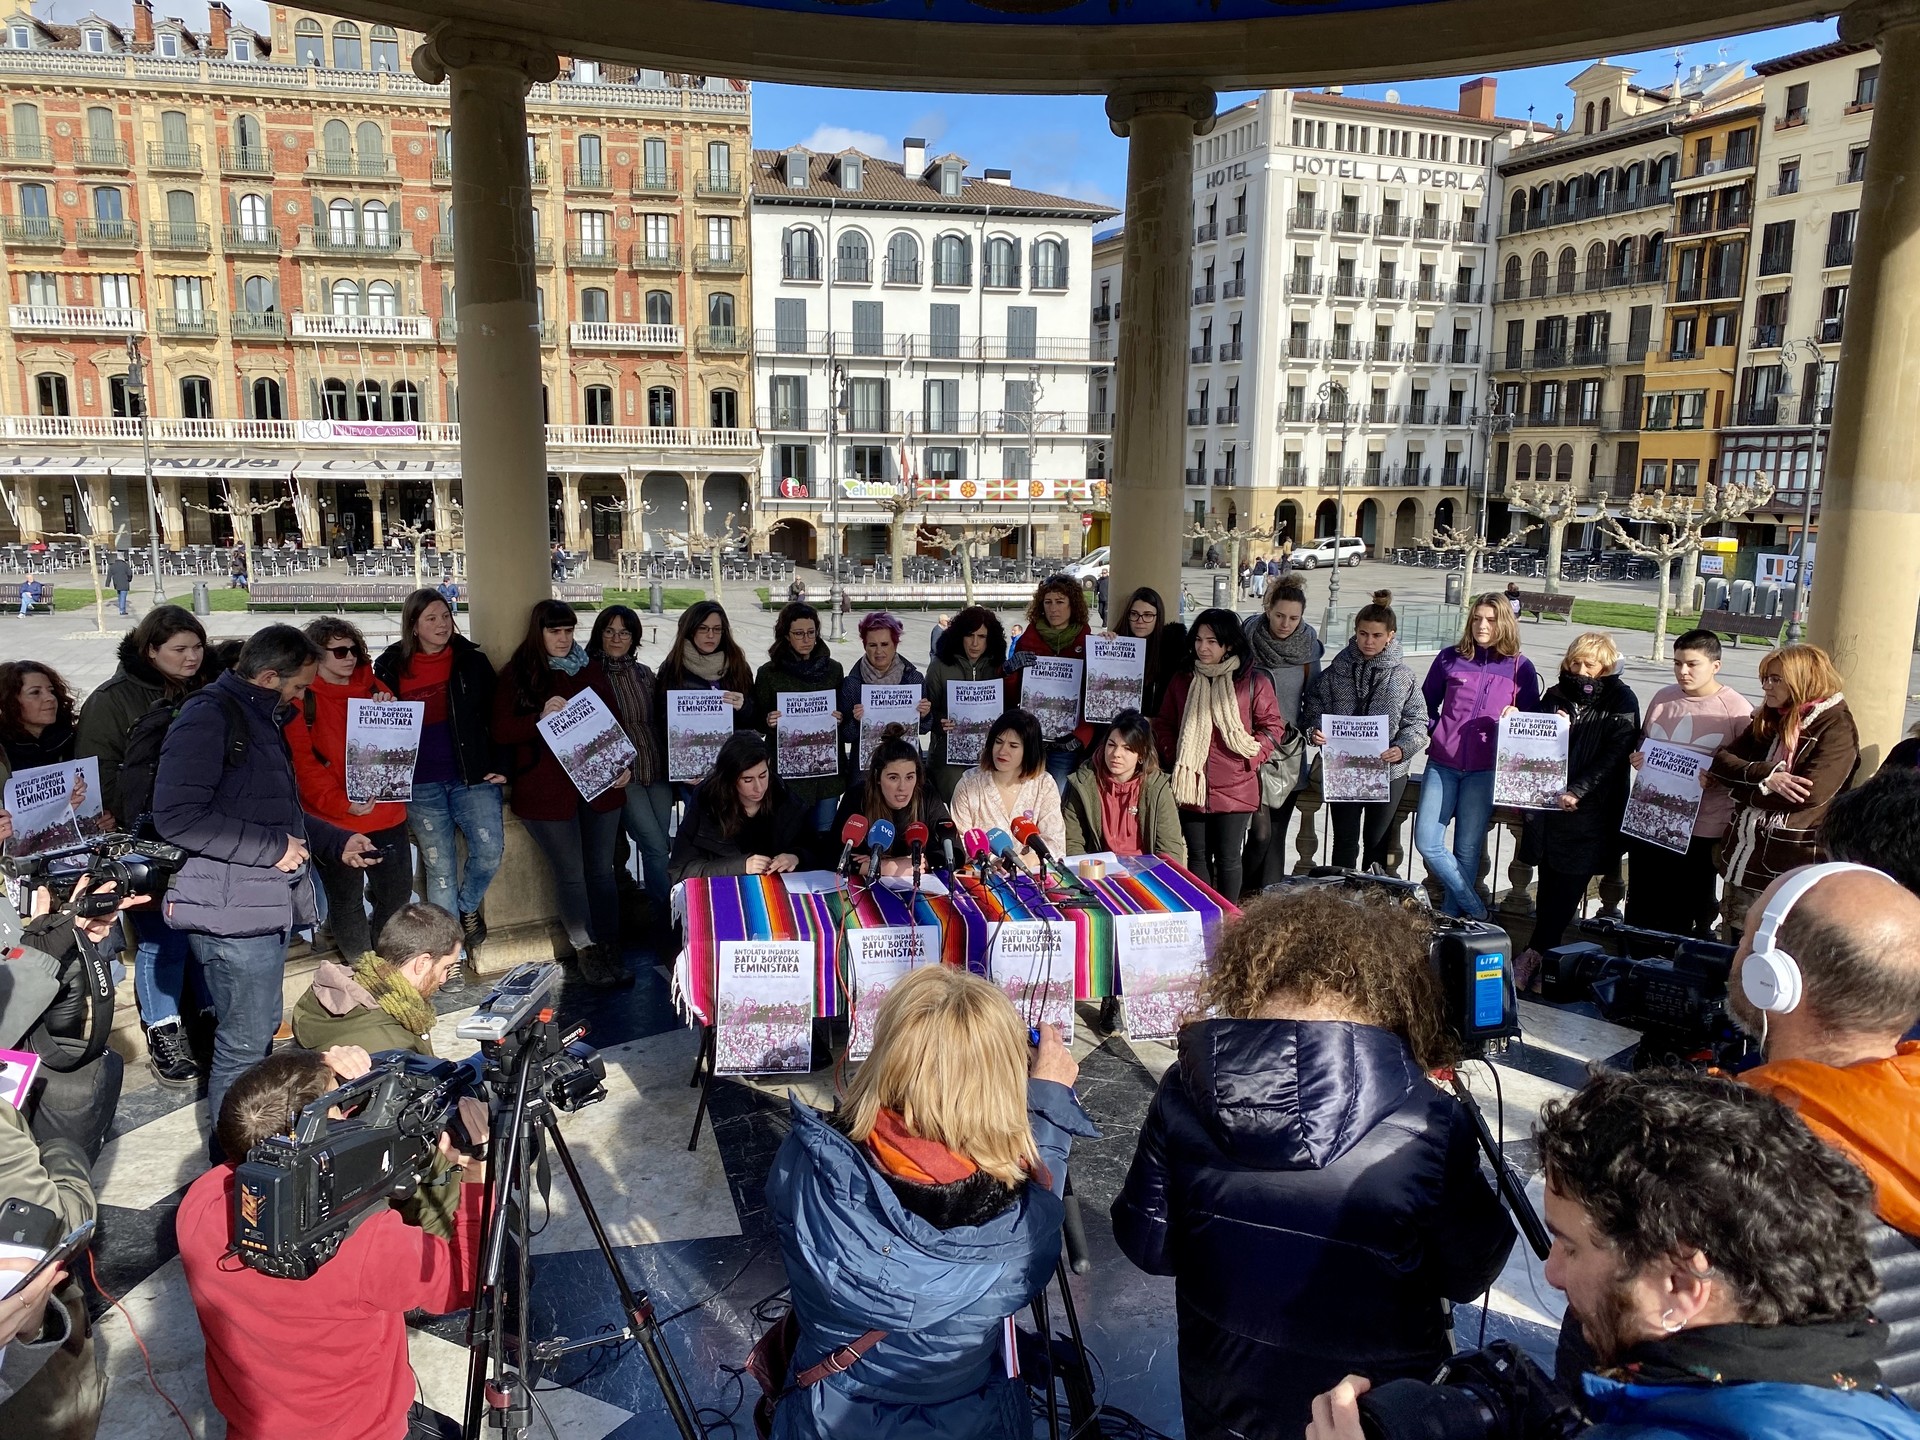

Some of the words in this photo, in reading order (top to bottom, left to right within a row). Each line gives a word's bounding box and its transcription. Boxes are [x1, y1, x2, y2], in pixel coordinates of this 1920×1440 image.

[1206, 160, 1252, 190] HOTEL
[1293, 154, 1364, 180] HOTEL
[1377, 164, 1407, 185] LA
[1418, 167, 1487, 192] PERLA
[792, 488, 808, 497] EA
[359, 717, 412, 726] FEMINISTARA
[553, 706, 596, 736] FEMINISTARA
[1509, 728, 1557, 737] FEMINISTARA
[1647, 757, 1694, 777] FEMINISTARA
[1650, 751, 1667, 760] BATU
[1669, 758, 1698, 769] BORROKA
[16, 786, 33, 798] BATU
[36, 777, 65, 792] BORROKA
[17, 785, 66, 808] FEMINISTARA
[881, 825, 893, 837] tve
[1130, 934, 1189, 945] FEMINISTARA
[734, 963, 798, 973] FEMINISTARA
[94, 960, 108, 996] Canon
